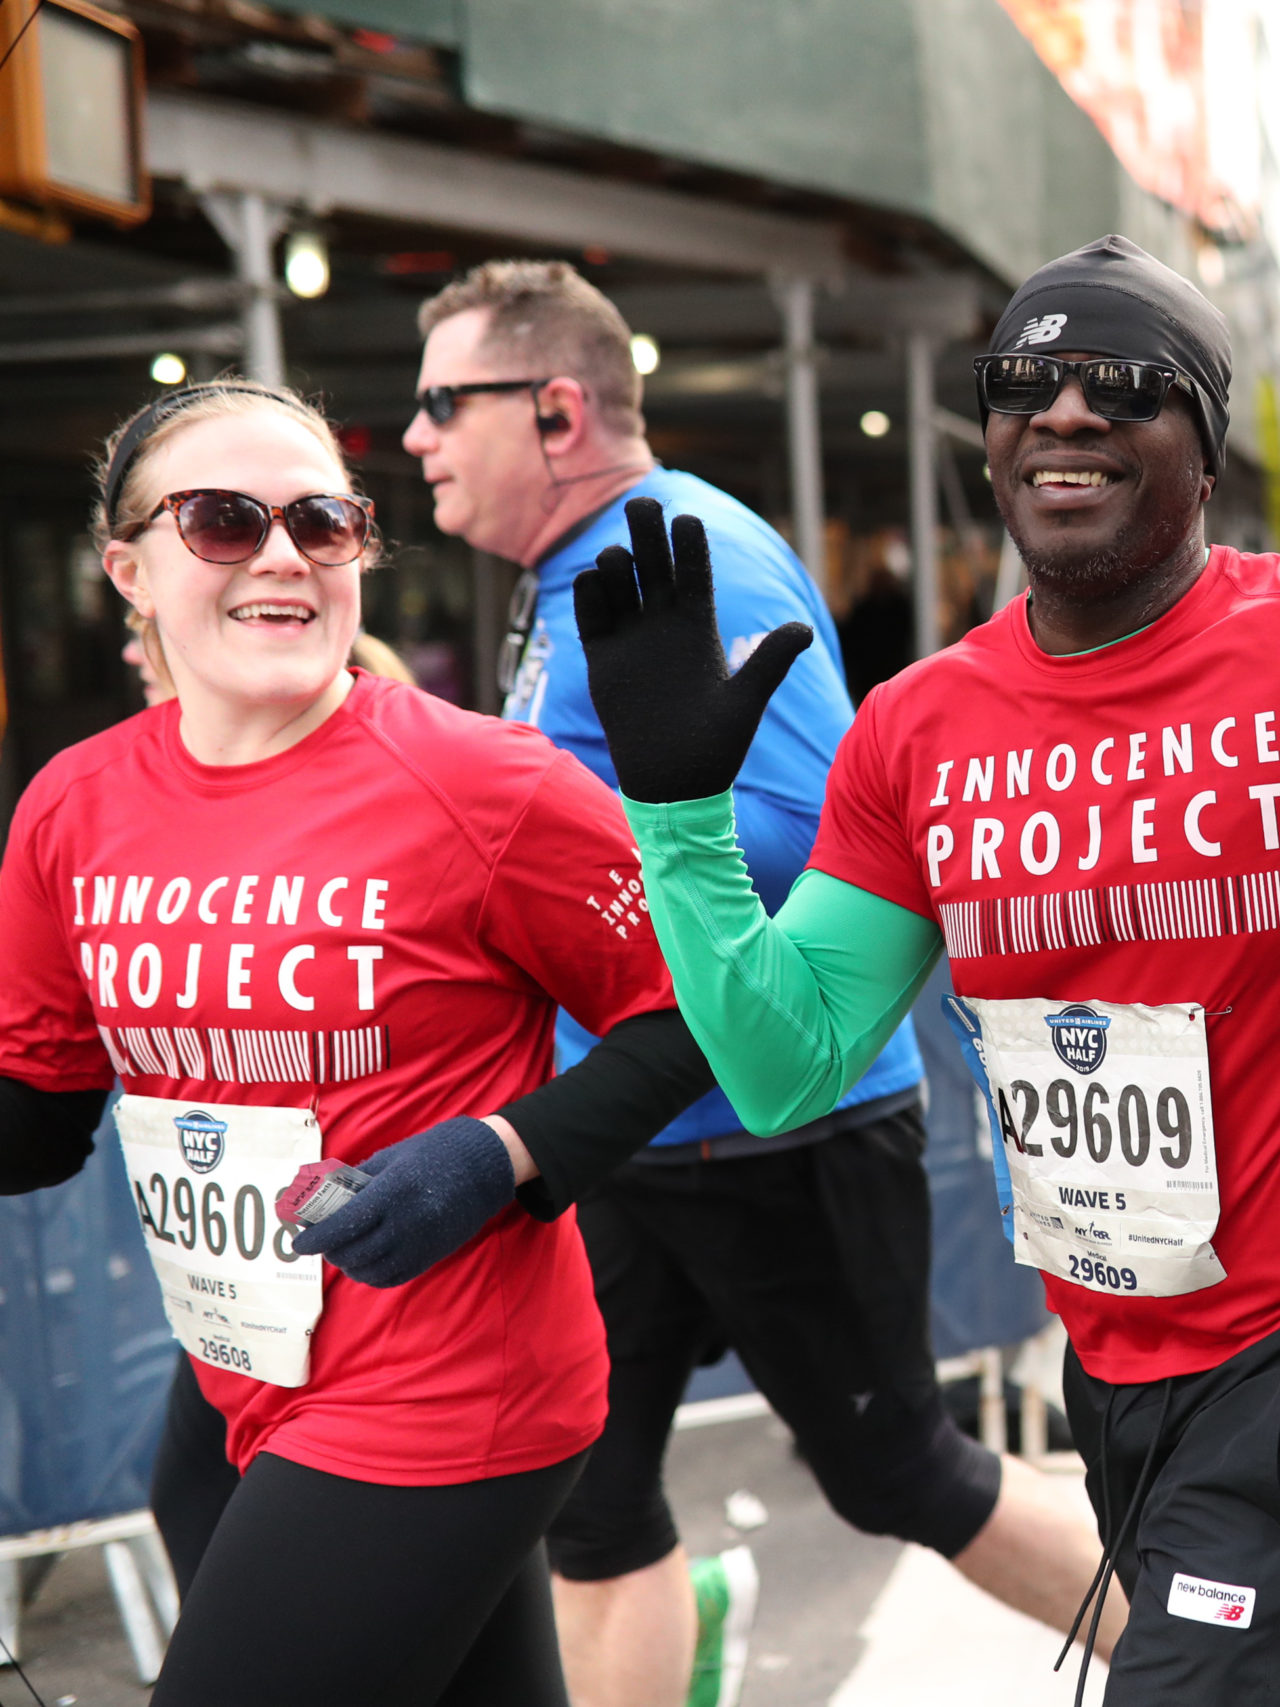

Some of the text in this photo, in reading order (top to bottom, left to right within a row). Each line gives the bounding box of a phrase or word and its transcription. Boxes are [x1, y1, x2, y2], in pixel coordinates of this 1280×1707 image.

[929, 711, 1280, 807] INNOCENCE
[72, 875, 389, 930] INNOCENCE
[80, 942, 384, 1011] PROJECT
[1060, 1028, 1098, 1049] NYC
[1066, 1047, 1096, 1062] HALF
[998, 1078, 1192, 1169] A29609
[183, 1130, 218, 1150] NYC
[186, 1149, 215, 1163] HALF
[1058, 1186, 1127, 1211] WAVE 5
[1128, 1233, 1184, 1247] #UnitedNYCHalf
[1068, 1254, 1138, 1291] 29609
[187, 1274, 237, 1300] WAVE 5
[198, 1337, 252, 1371] 29608
[1177, 1582, 1246, 1603] new balance
